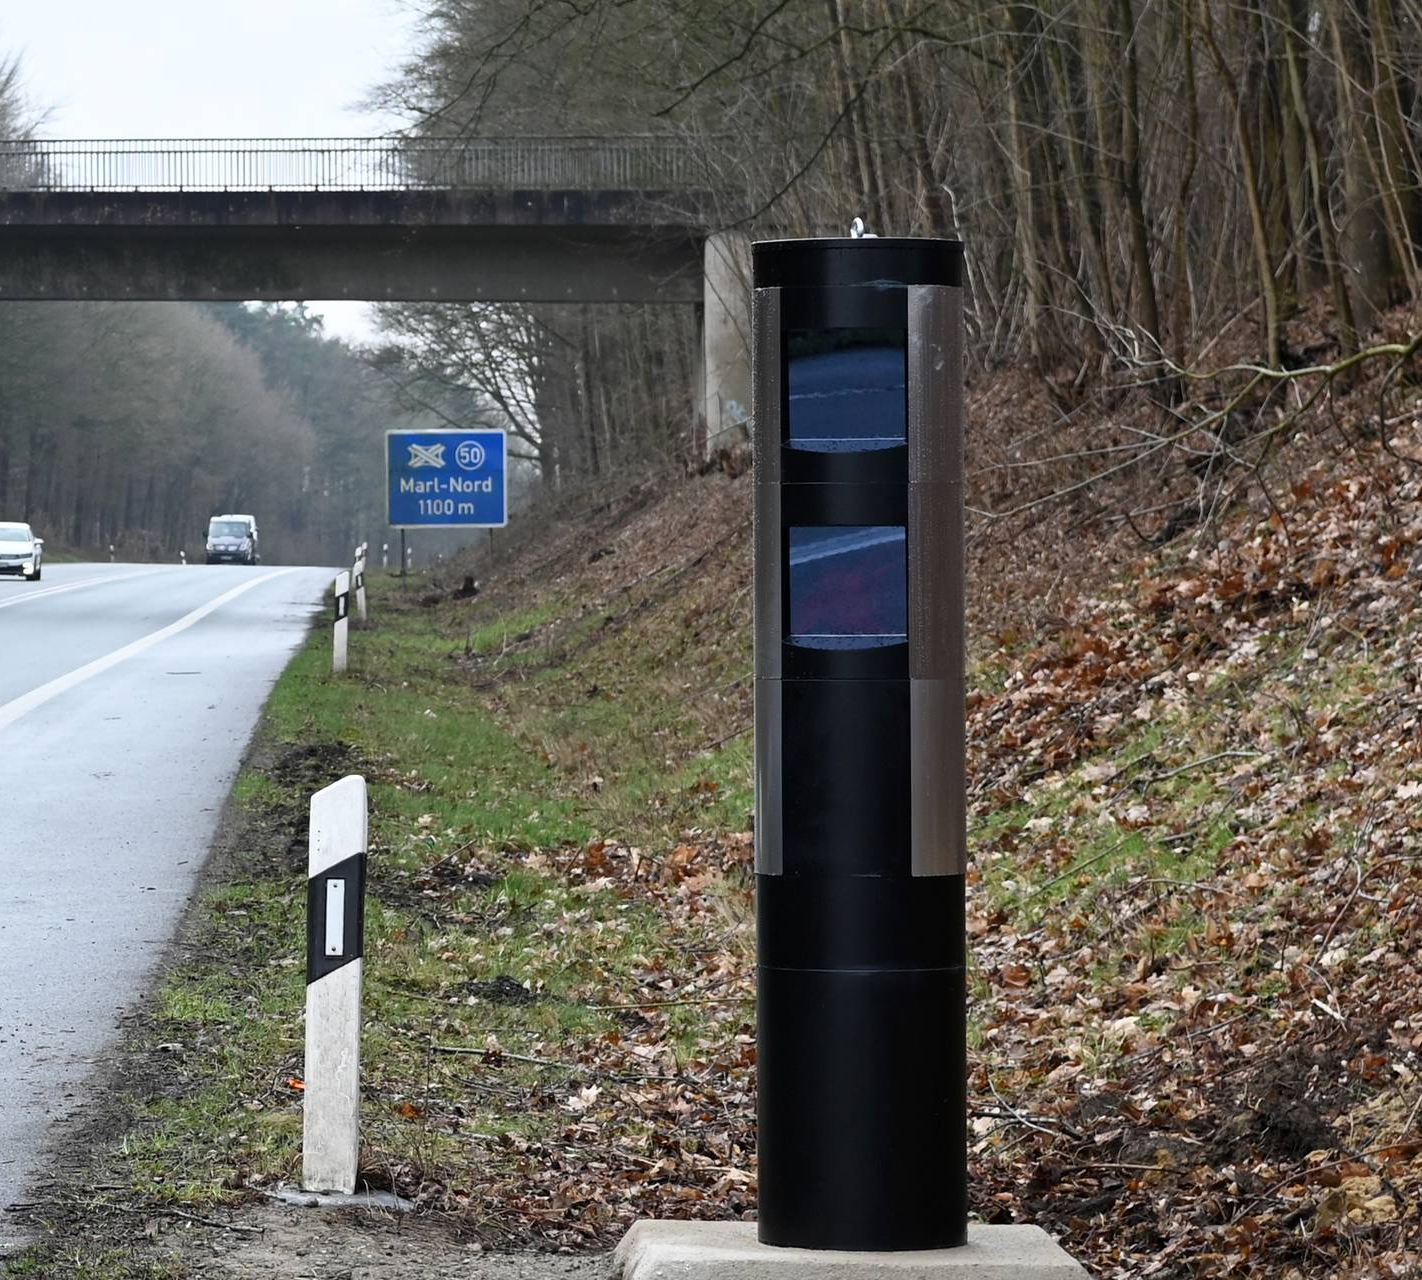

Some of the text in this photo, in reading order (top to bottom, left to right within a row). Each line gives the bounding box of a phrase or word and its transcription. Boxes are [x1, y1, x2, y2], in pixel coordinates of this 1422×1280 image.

[460, 448, 480, 463] 50
[400, 477, 492, 493] Marl-Nord
[418, 500, 474, 515] 1100 m
